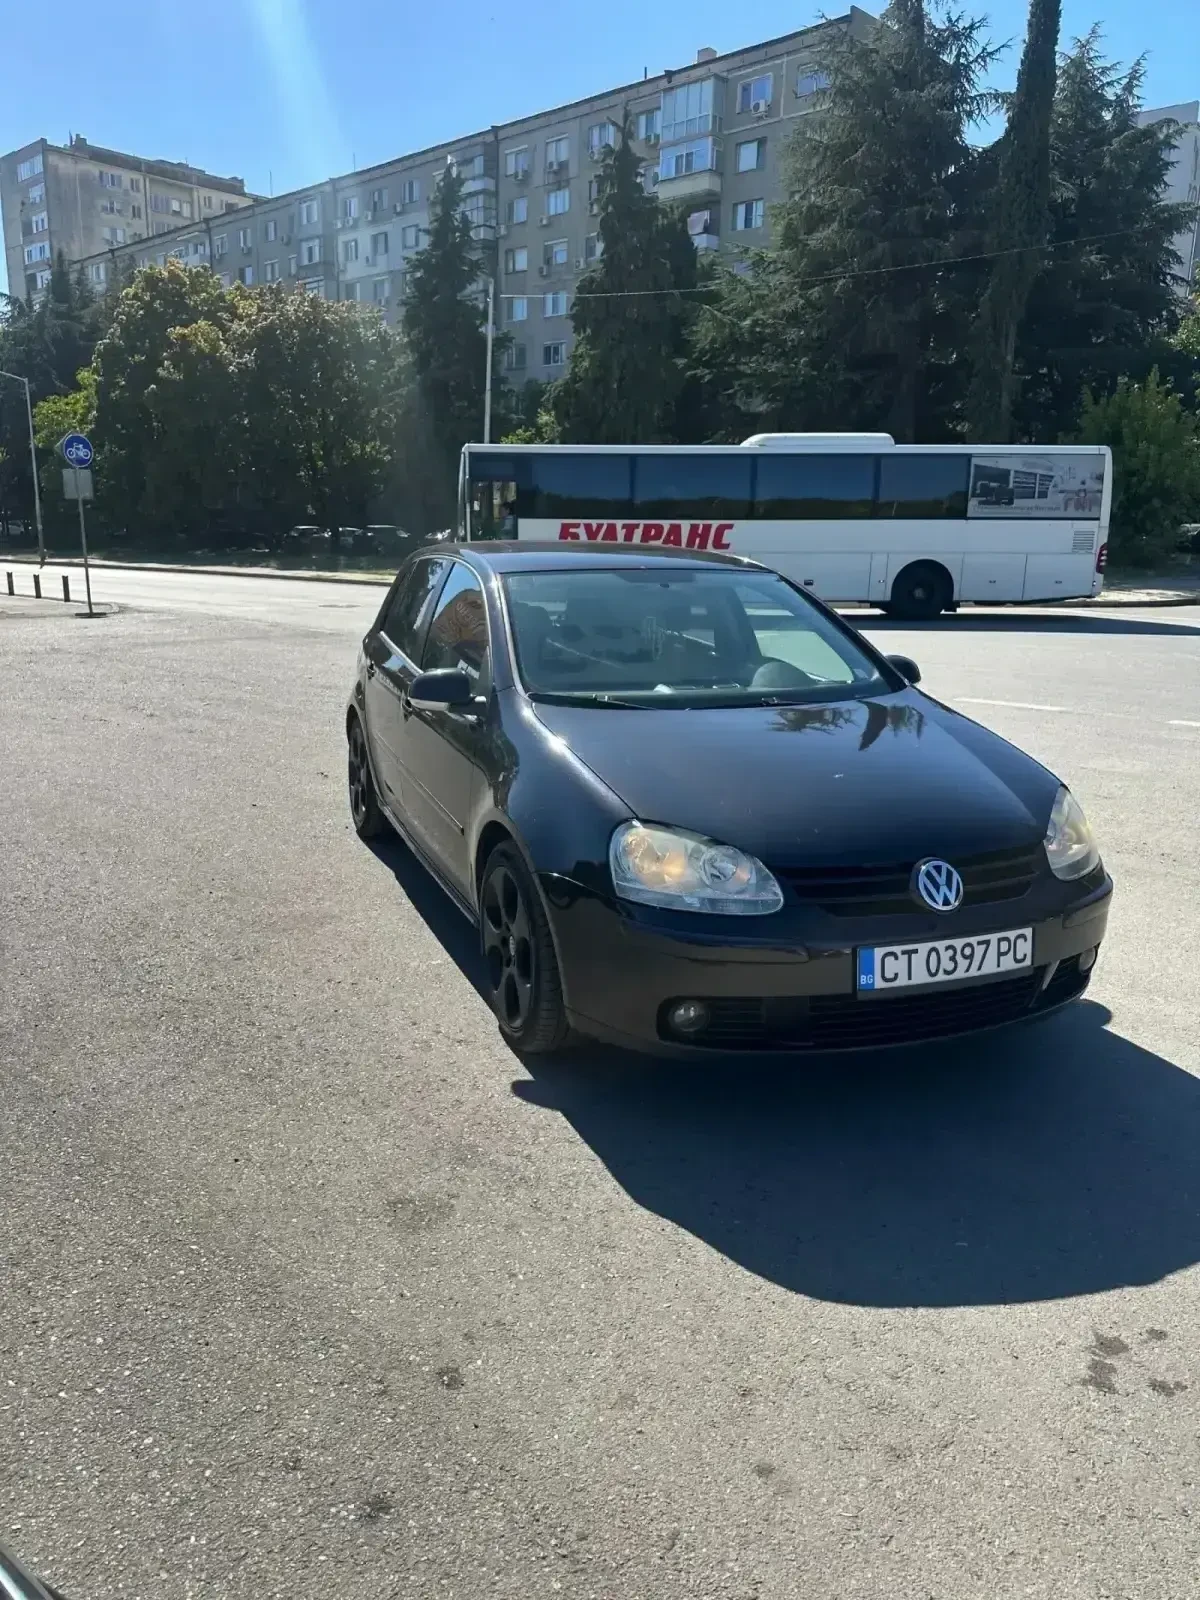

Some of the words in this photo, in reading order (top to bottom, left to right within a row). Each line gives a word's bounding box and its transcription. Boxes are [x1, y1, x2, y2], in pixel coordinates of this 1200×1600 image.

[880, 949, 919, 983] CT
[925, 939, 992, 978] 0397
[996, 933, 1028, 968] PC
[860, 974, 874, 985] BG
